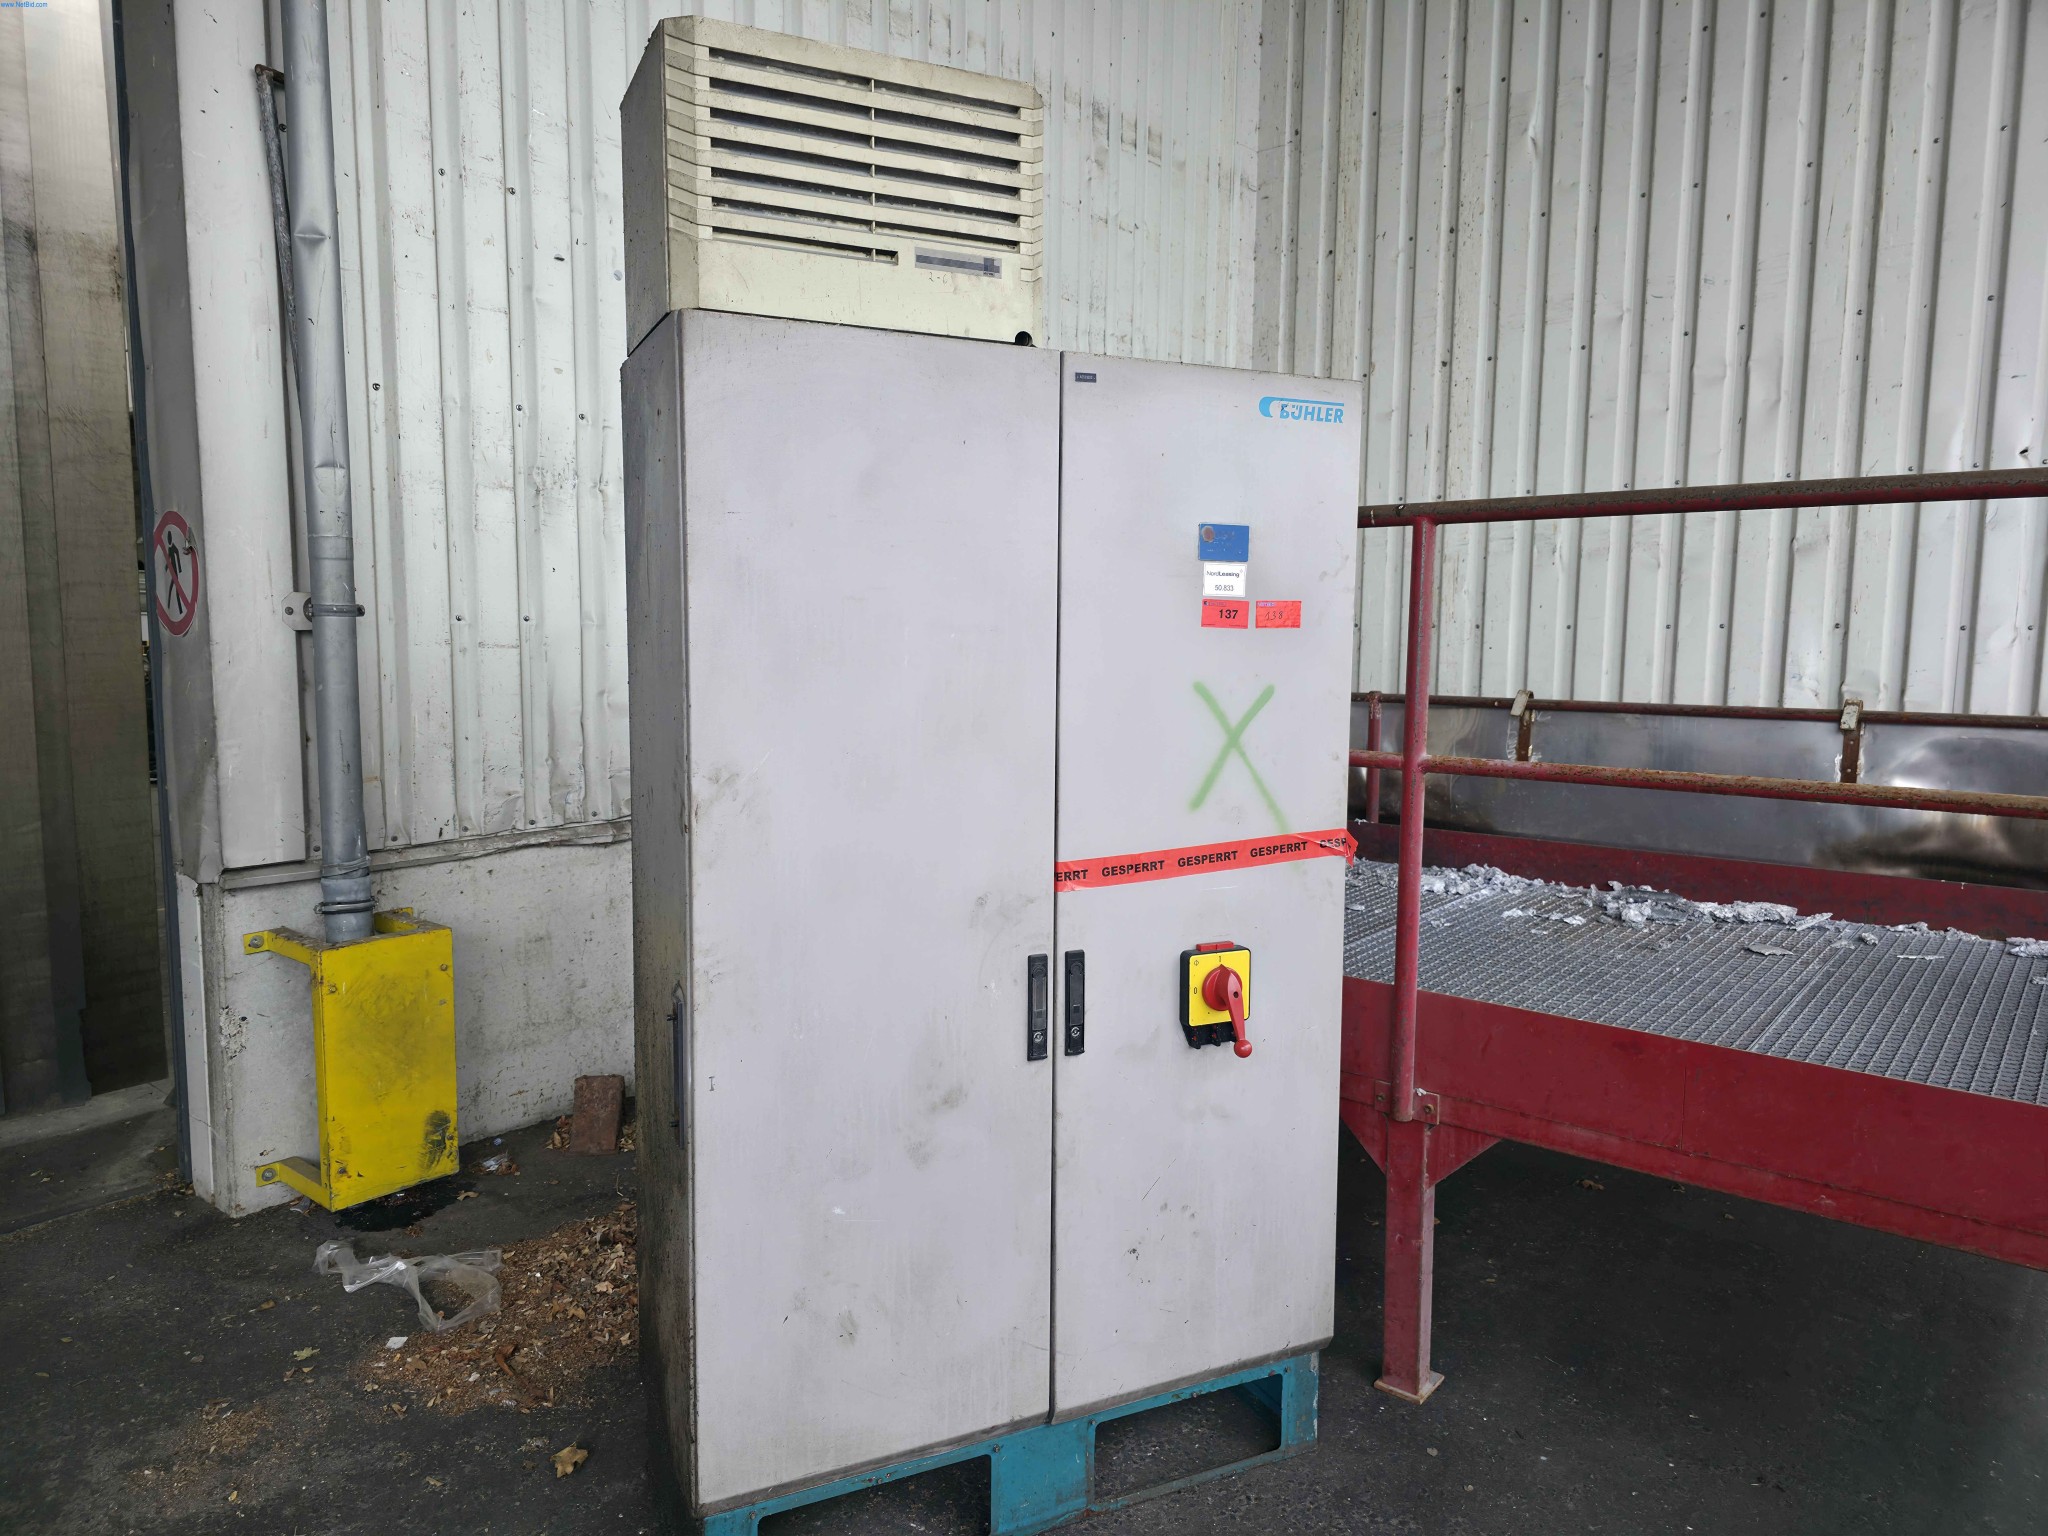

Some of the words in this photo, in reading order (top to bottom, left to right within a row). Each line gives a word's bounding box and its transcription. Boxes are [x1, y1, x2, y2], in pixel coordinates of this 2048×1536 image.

[1279, 403, 1344, 424] BÜHLER
[1206, 570, 1240, 579] NordLeasing
[1219, 608, 1239, 619] 137
[1055, 869, 1089, 882] ERRT
[1101, 860, 1165, 877] GESPERRT
[1177, 850, 1238, 868] GESPERRT
[1250, 841, 1308, 858] GESPERRT
